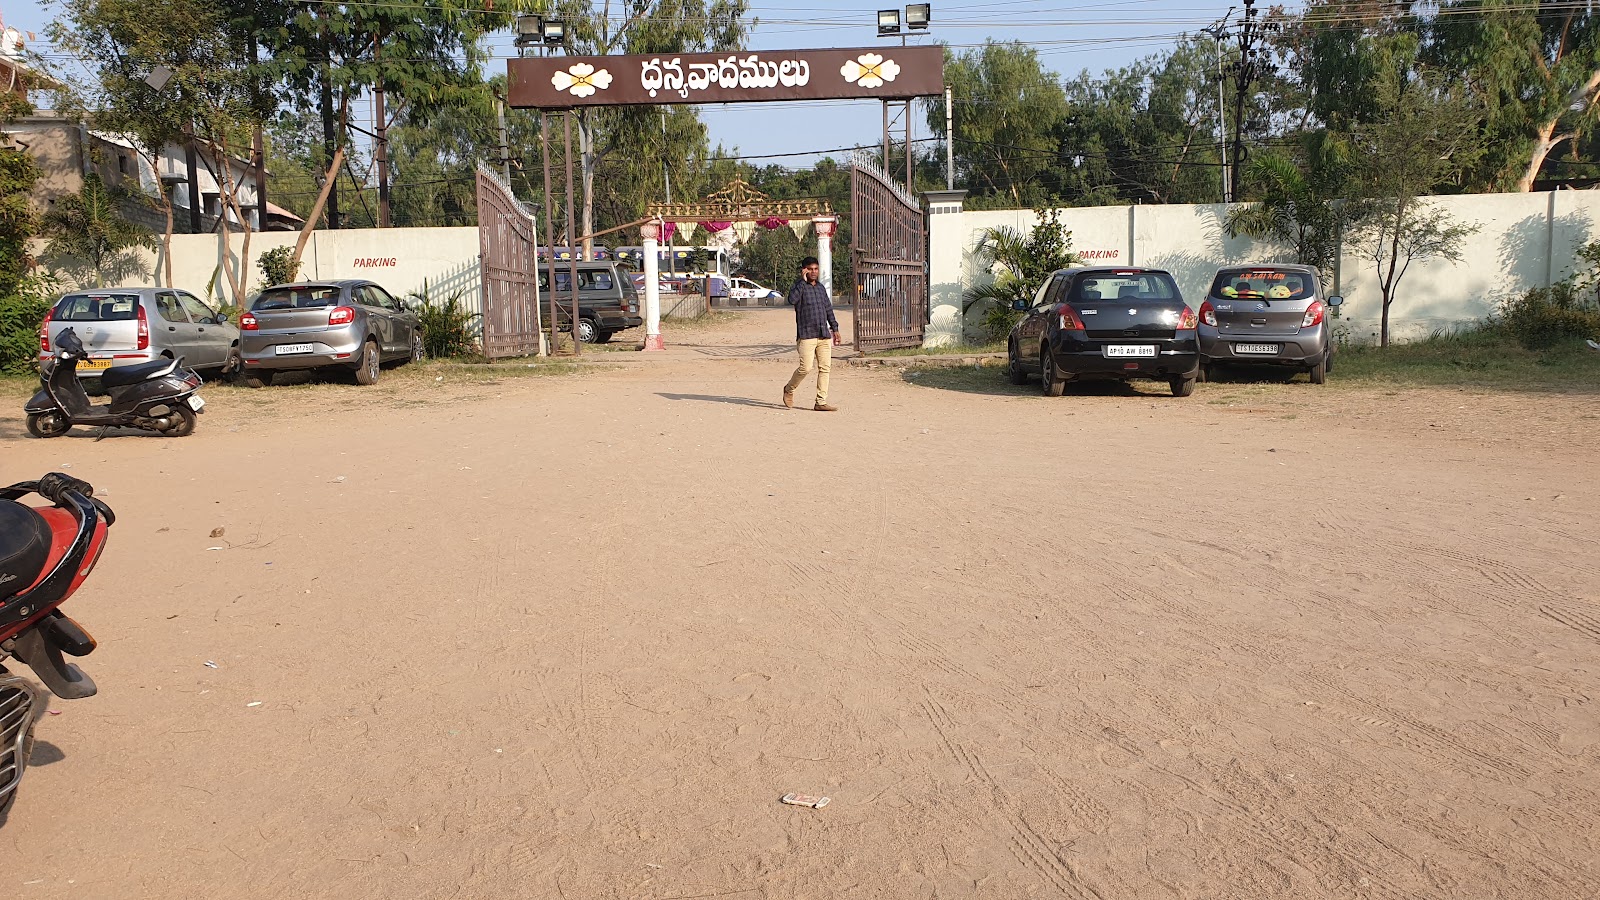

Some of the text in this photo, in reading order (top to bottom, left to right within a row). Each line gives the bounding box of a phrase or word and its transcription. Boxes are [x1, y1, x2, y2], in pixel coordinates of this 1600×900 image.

[641, 55, 810, 98] ధన్యవాదములు
[1079, 250, 1119, 259] PARKING
[353, 257, 397, 268] PARKING
